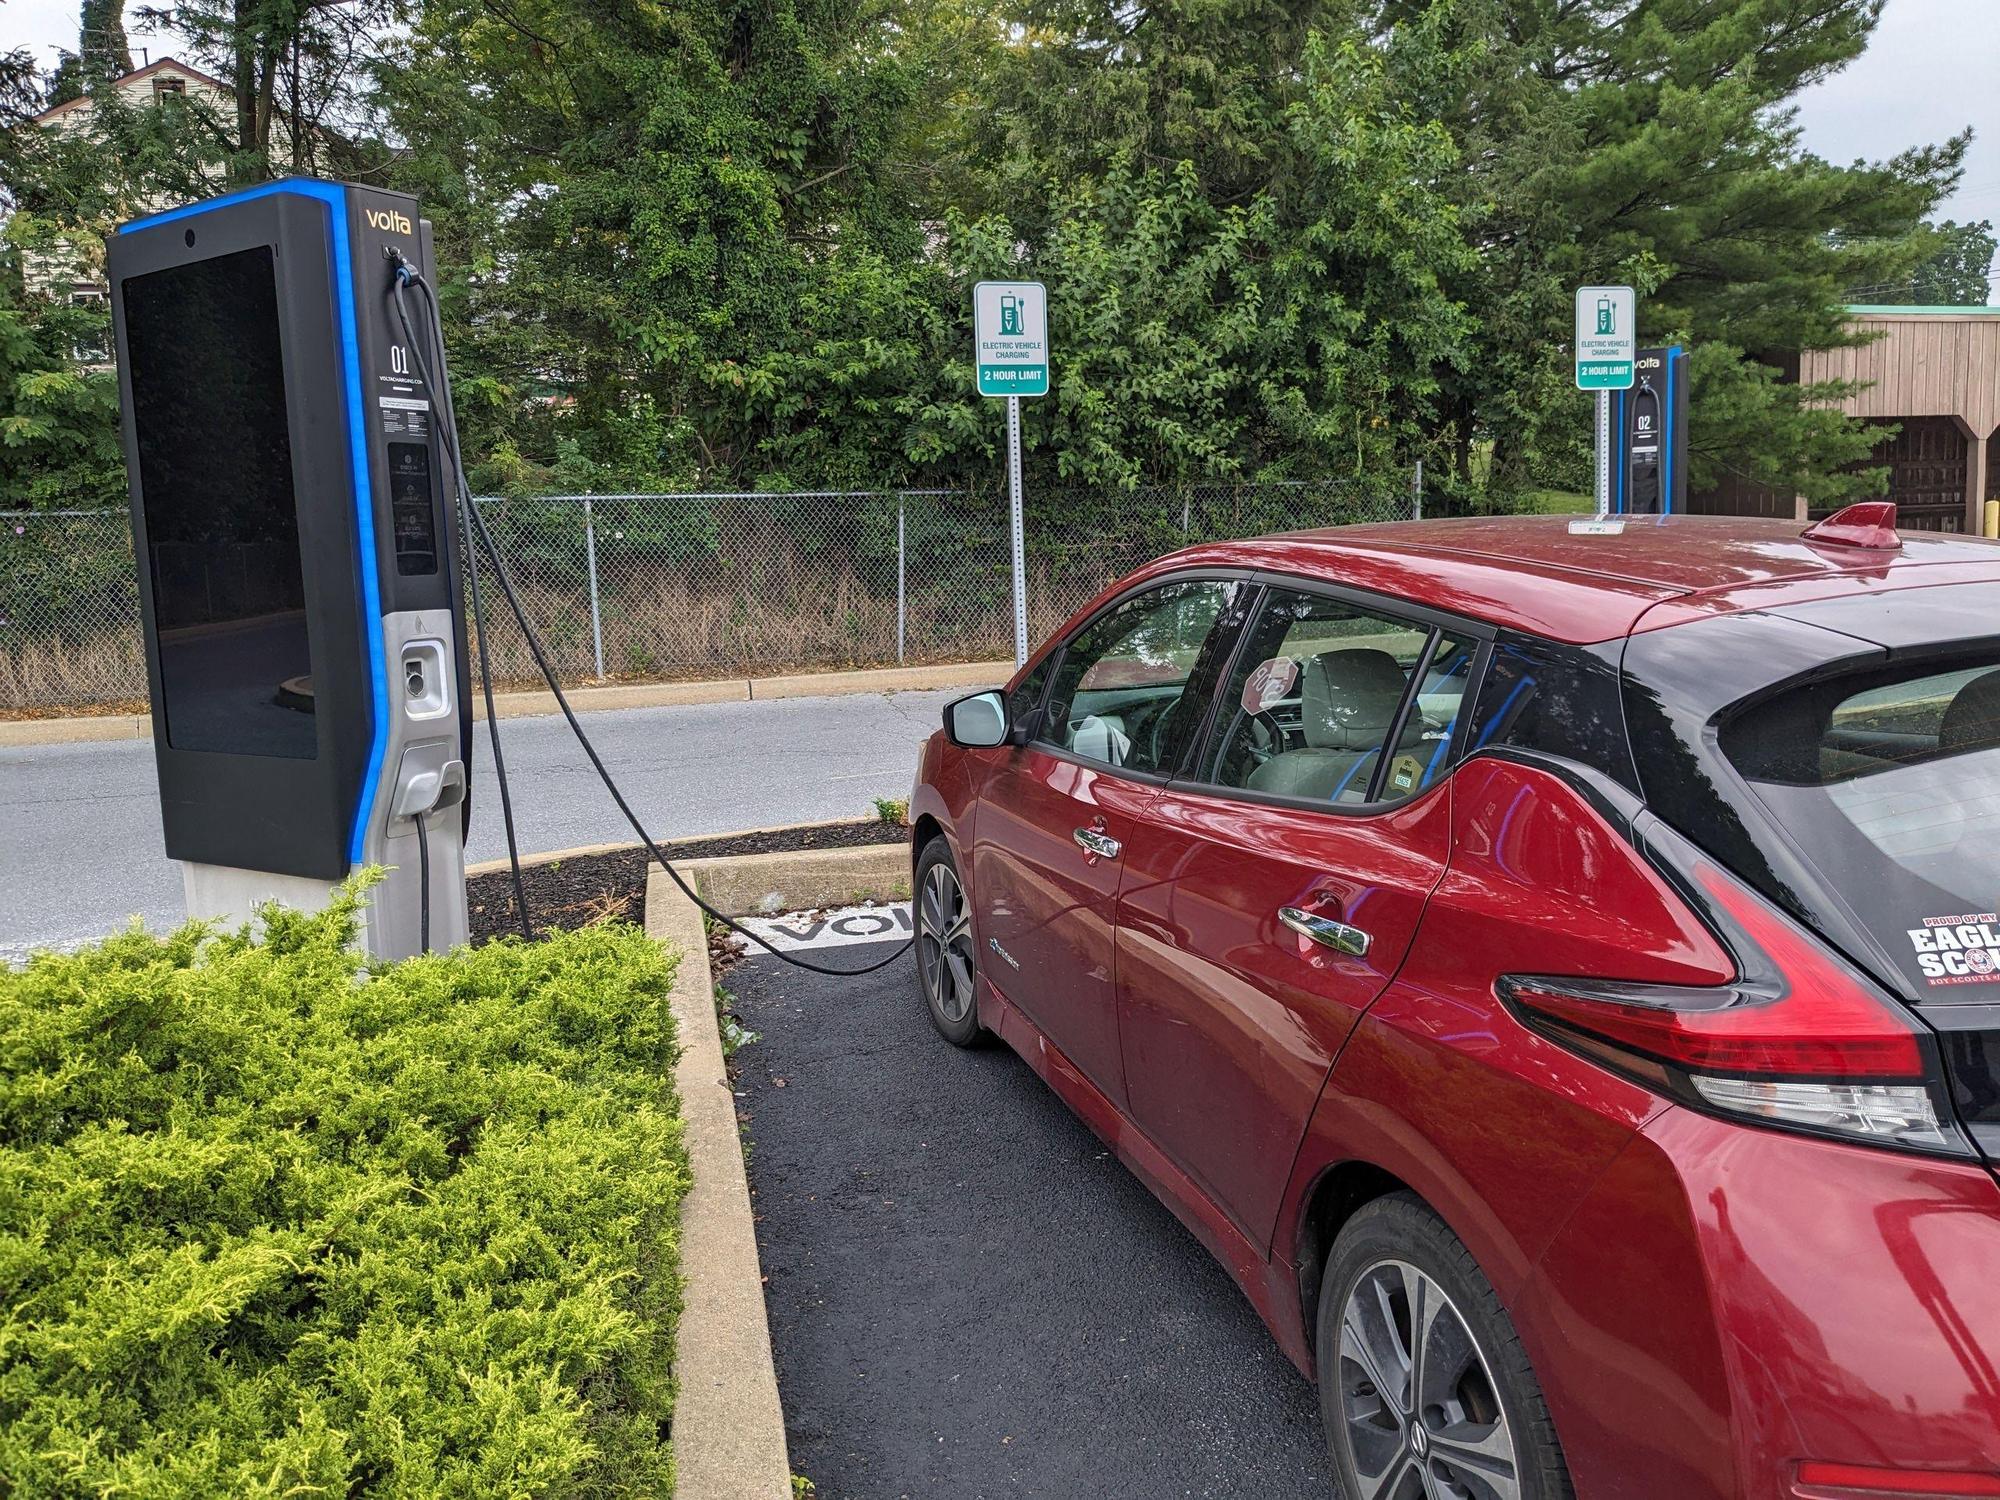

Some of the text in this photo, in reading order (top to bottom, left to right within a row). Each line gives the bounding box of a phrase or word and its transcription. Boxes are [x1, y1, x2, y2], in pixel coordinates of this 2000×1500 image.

[366, 209, 411, 235] volta
[1005, 310, 1012, 330] EV
[391, 346, 409, 374] 01
[984, 371, 1042, 380] 2 HOUR LIMIT
[1589, 367, 1608, 375] HOUR
[1609, 366, 1629, 374] LIMIT
[1639, 416, 1650, 430] 02
[1924, 916, 1961, 926] PROUD
[1907, 924, 2000, 953] EAGL
